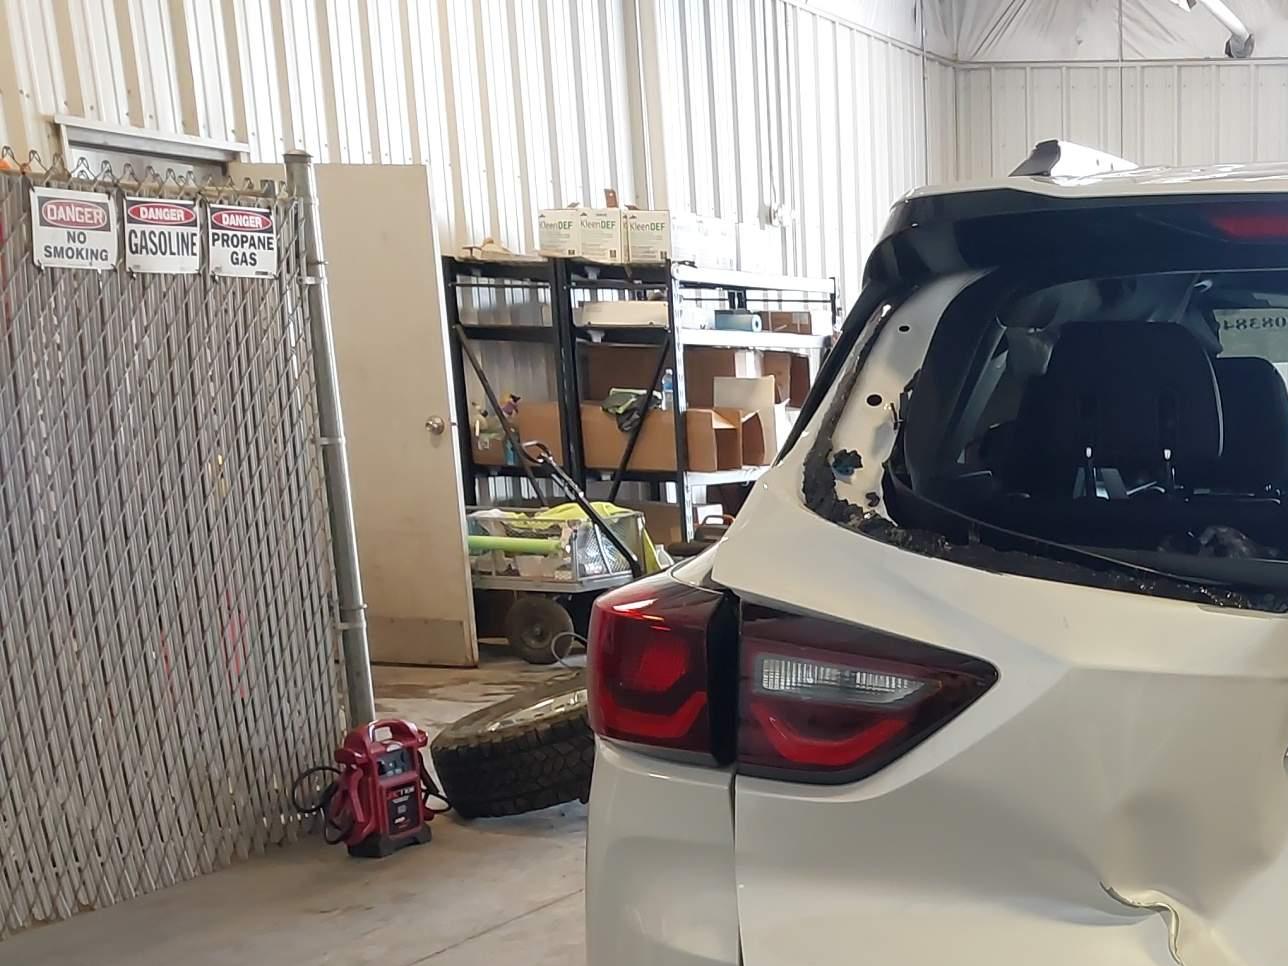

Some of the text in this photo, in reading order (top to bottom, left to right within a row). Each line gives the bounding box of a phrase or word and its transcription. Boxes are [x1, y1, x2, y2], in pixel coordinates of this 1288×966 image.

[46, 204, 103, 225] DANGER
[139, 206, 185, 222] DANGER
[221, 212, 263, 228] DANGER
[580, 218, 616, 230] KleenDEF
[630, 222, 665, 232] KleenDEF
[66, 230, 87, 244] NO
[128, 229, 198, 257] GASOLINE
[211, 232, 274, 251] PROPANE
[43, 245, 109, 262] SMOKING
[230, 251, 258, 267] GAS
